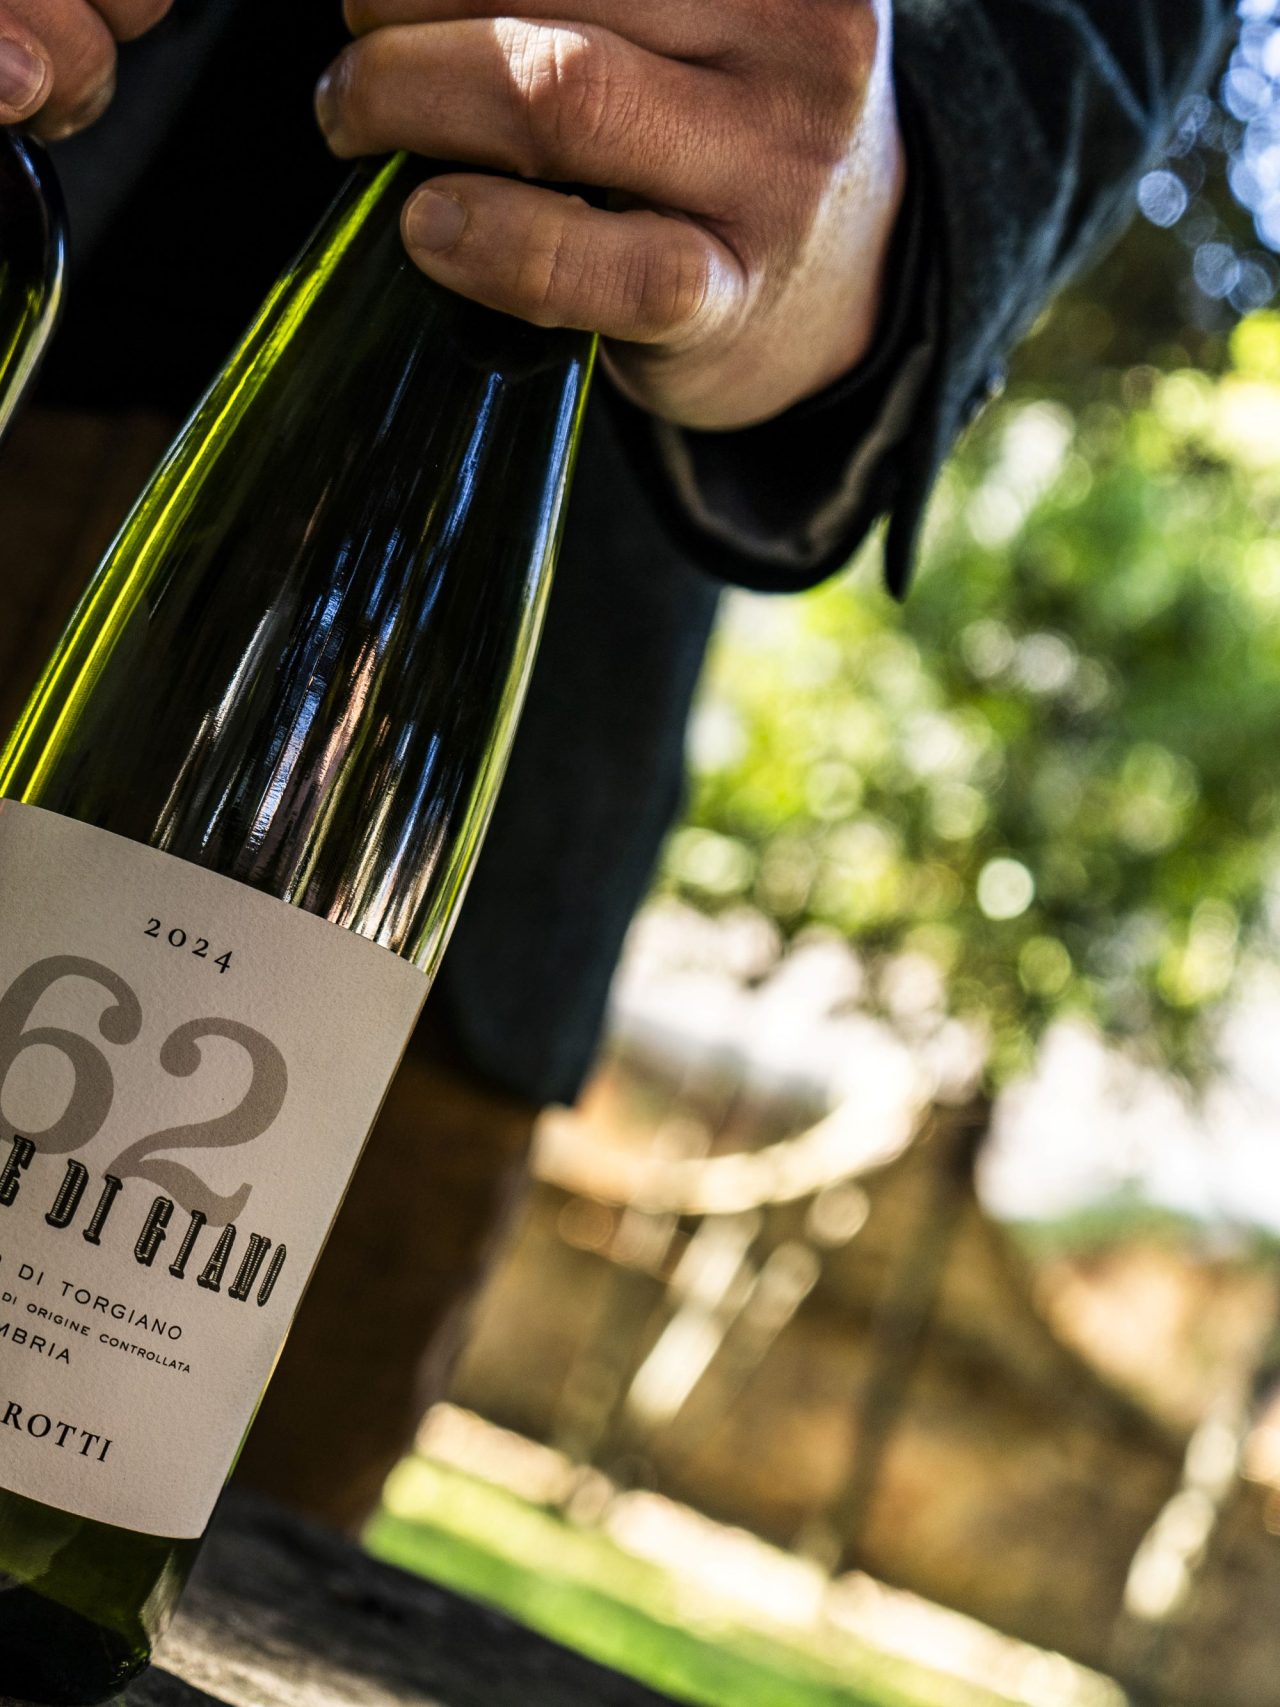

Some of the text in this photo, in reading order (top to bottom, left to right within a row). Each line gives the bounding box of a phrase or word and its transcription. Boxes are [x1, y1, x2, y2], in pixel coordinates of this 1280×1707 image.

[144, 918, 232, 972] 2024
[45, 1159, 124, 1245] DI
[134, 1196, 288, 1307] GIANO
[2, 1292, 16, 1304] DI
[26, 1303, 90, 1336] ORIGINE
[99, 1333, 191, 1374] CONTROLLATA
[18, 1262, 44, 1286] DI
[61, 1279, 184, 1340] TORGIANO
